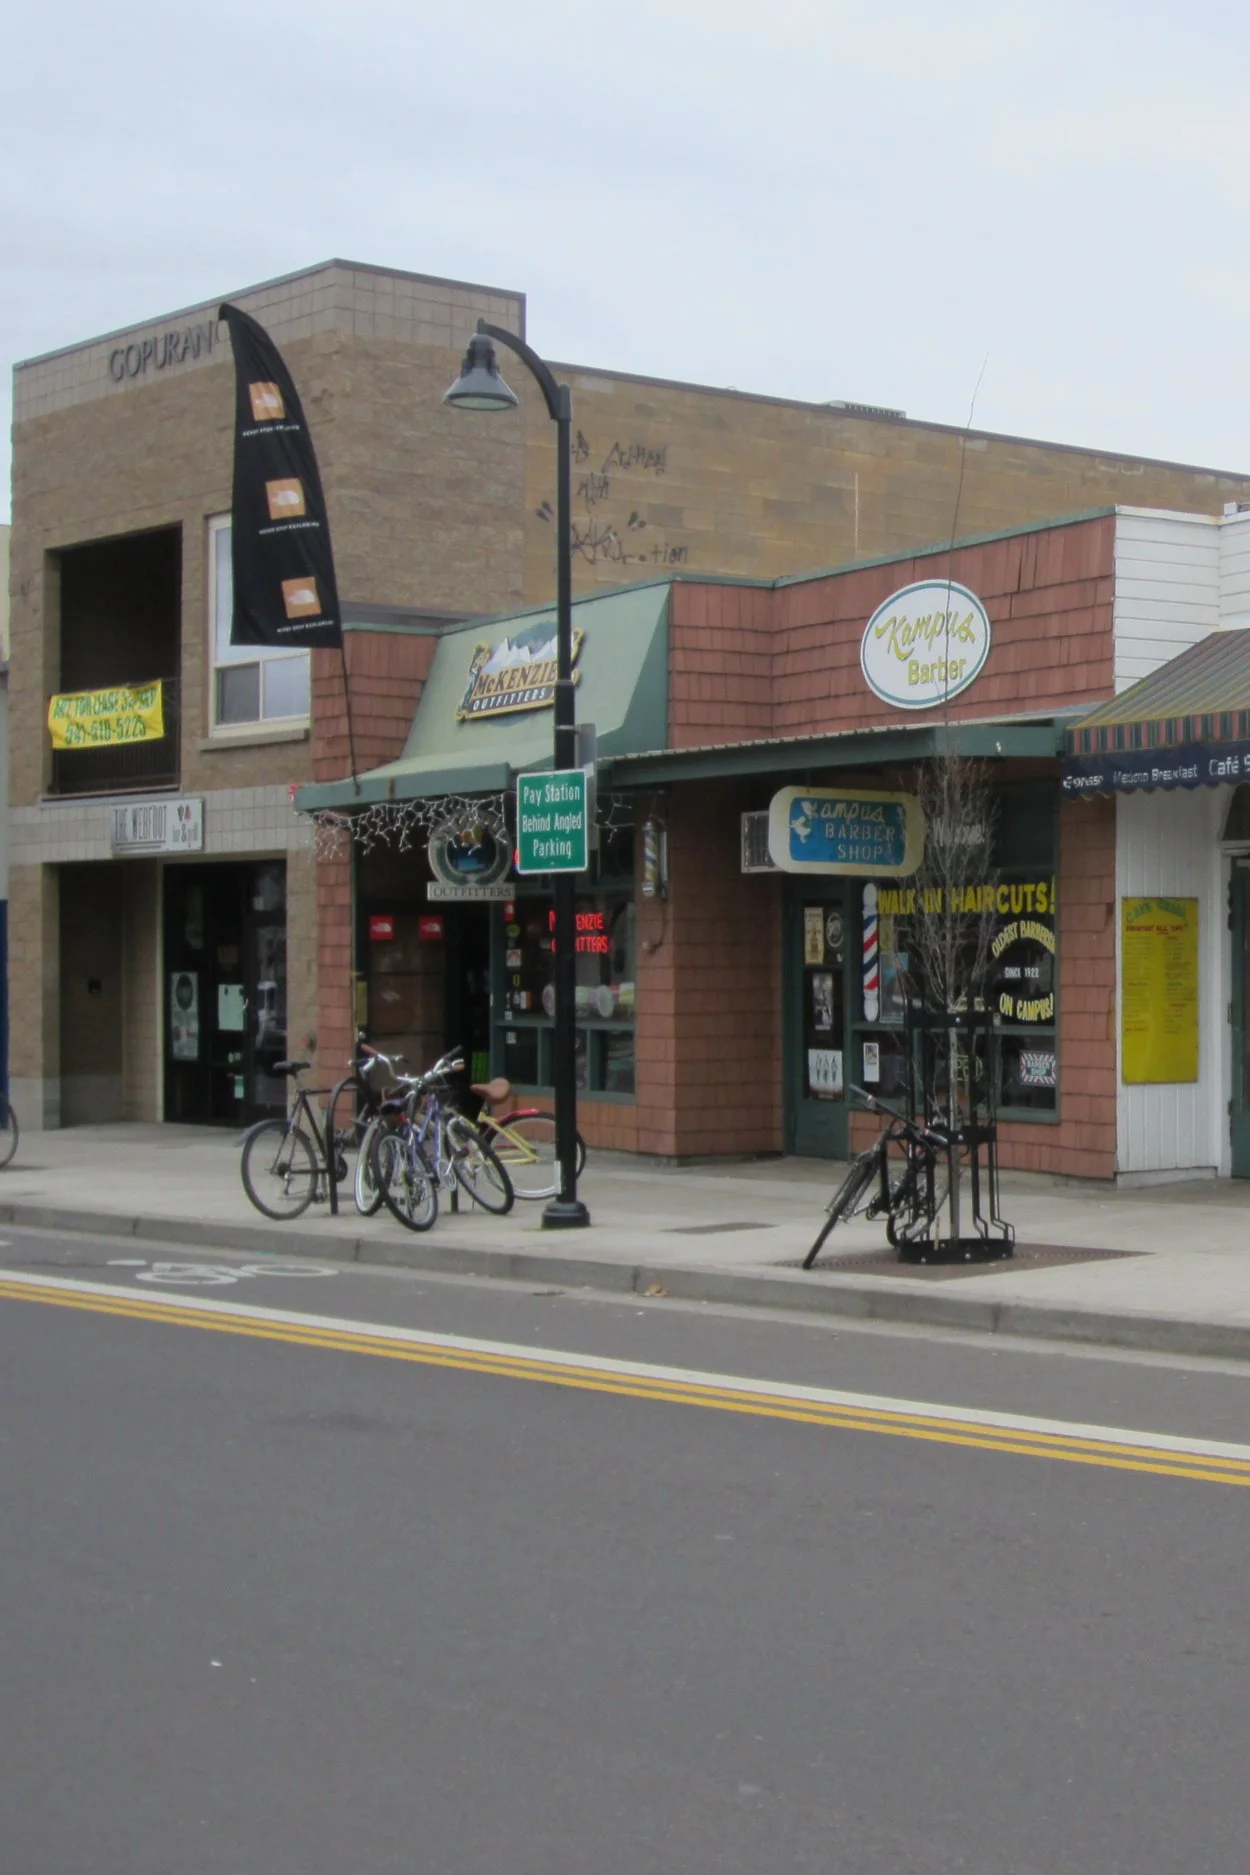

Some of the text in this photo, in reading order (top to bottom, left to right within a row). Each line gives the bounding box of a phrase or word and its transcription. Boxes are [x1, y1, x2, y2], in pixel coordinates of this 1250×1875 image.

[908, 656, 967, 686] Barber
[473, 687, 546, 711] OUTFITTERS
[523, 782, 580, 807] Pay Station
[522, 811, 582, 834] Behind Angled
[825, 823, 896, 841] BARBER
[532, 838, 572, 860] Parking
[837, 843, 884, 860] SHOP
[434, 887, 511, 898] OUTFITTERS
[878, 889, 916, 914] WALK
[951, 876, 1056, 914] HAIRCUTS!
[992, 921, 1018, 958] OLDEST
[1004, 966, 1021, 978] SINCE
[1000, 992, 1054, 1021] ON CAMPUS!
